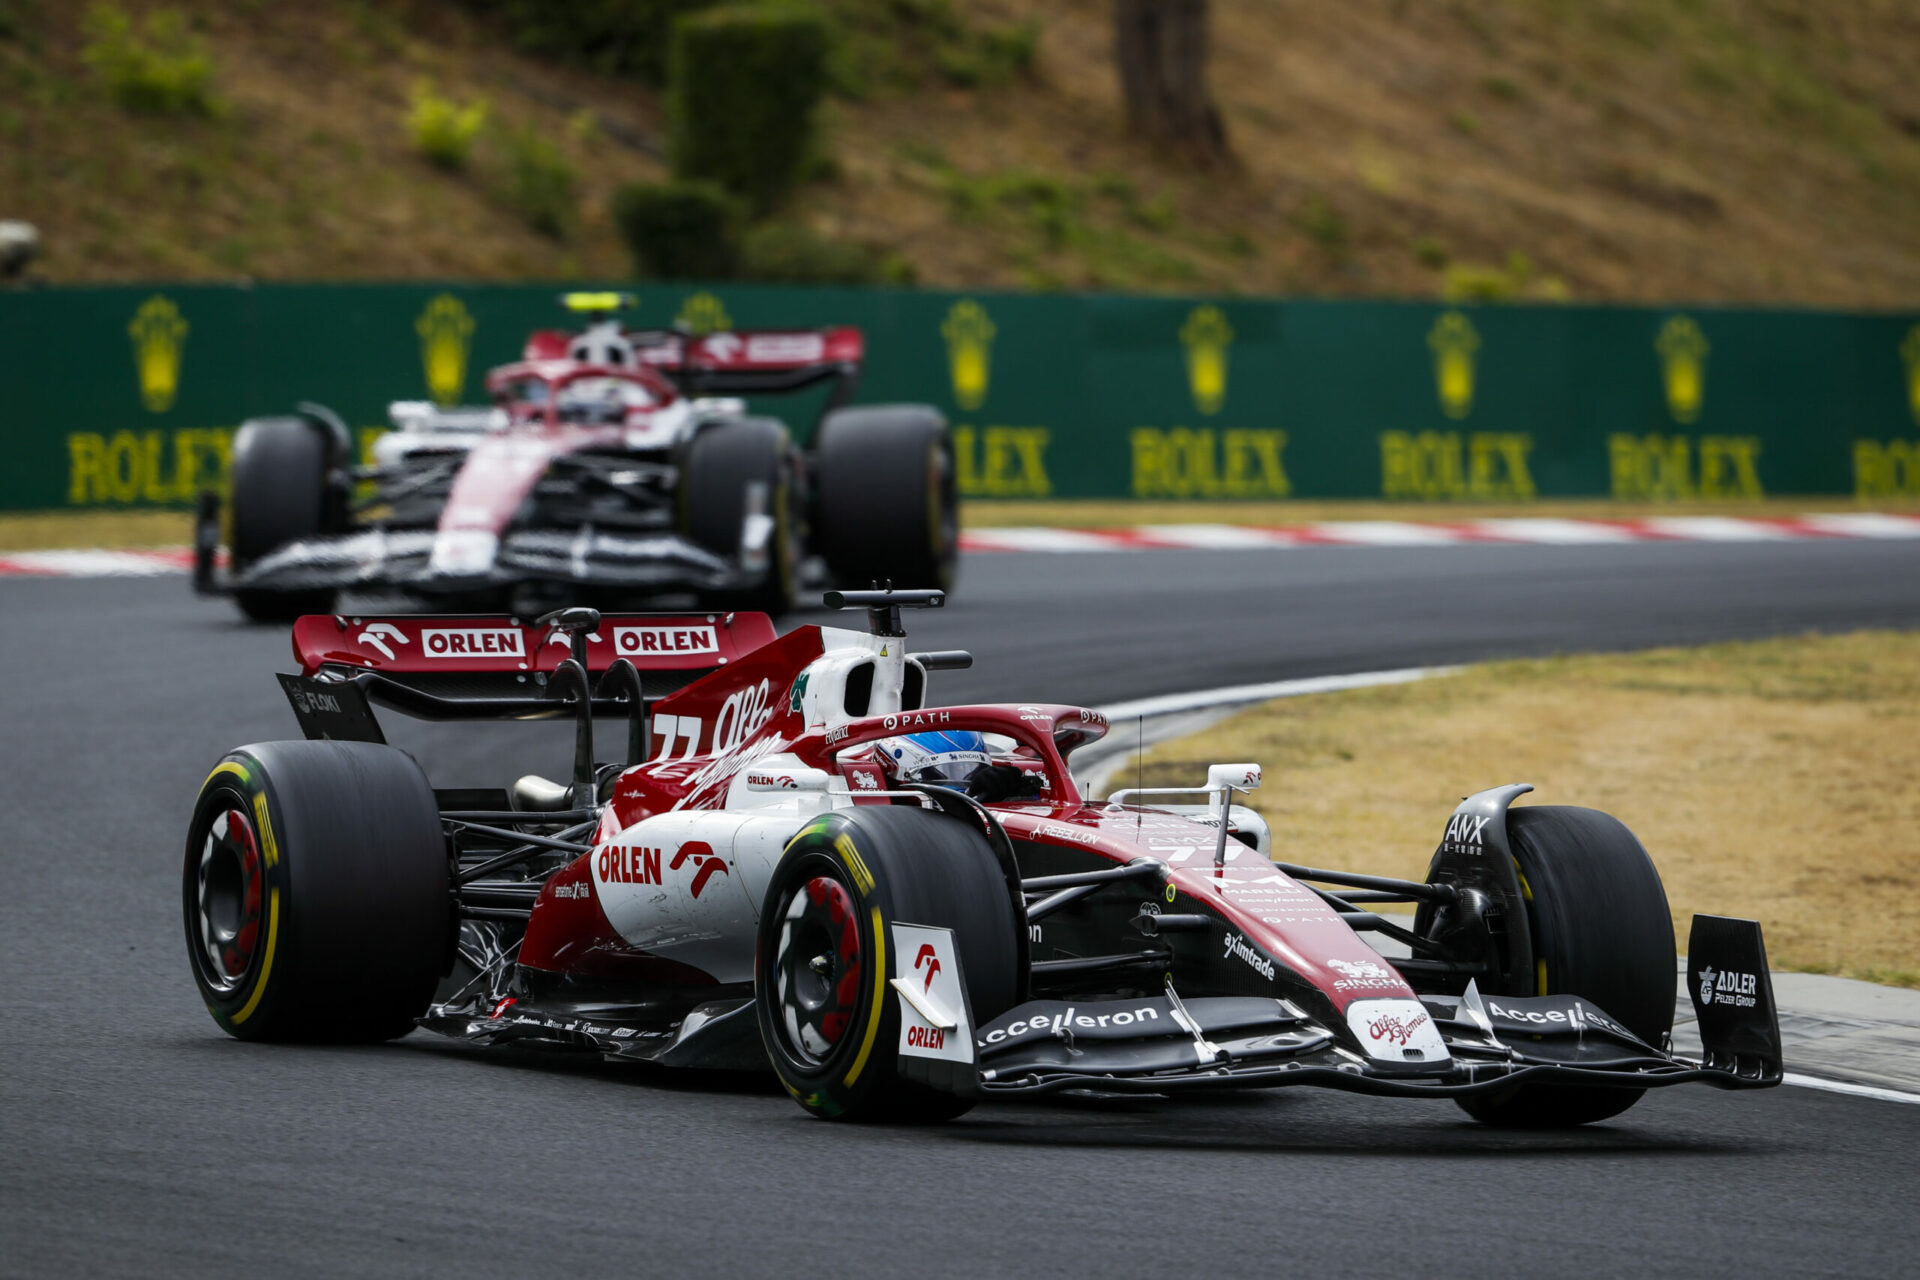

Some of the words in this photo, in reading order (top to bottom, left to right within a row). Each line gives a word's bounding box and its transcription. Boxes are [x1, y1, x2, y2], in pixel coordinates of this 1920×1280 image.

[953, 426, 1053, 495] LEX
[1131, 427, 1292, 497] ROLEX
[1381, 430, 1537, 499] ROLEX
[1609, 433, 1764, 501] ROLEX
[428, 633, 518, 654] ORLEN
[620, 631, 711, 651] ORLEN
[305, 692, 341, 712] FLOKI
[902, 711, 950, 726] PATH
[747, 775, 774, 786] ORLEN
[1043, 825, 1100, 845] REBELLION
[1148, 845, 1246, 862] 77
[598, 845, 663, 886] ORLEN
[1223, 931, 1276, 982] aximtrade
[1333, 978, 1409, 990] SINGHA
[1715, 970, 1757, 995] ADLER
[1714, 992, 1736, 1005] PELZER
[1735, 994, 1757, 1008] GROUP
[907, 1025, 945, 1050] ORLEN
